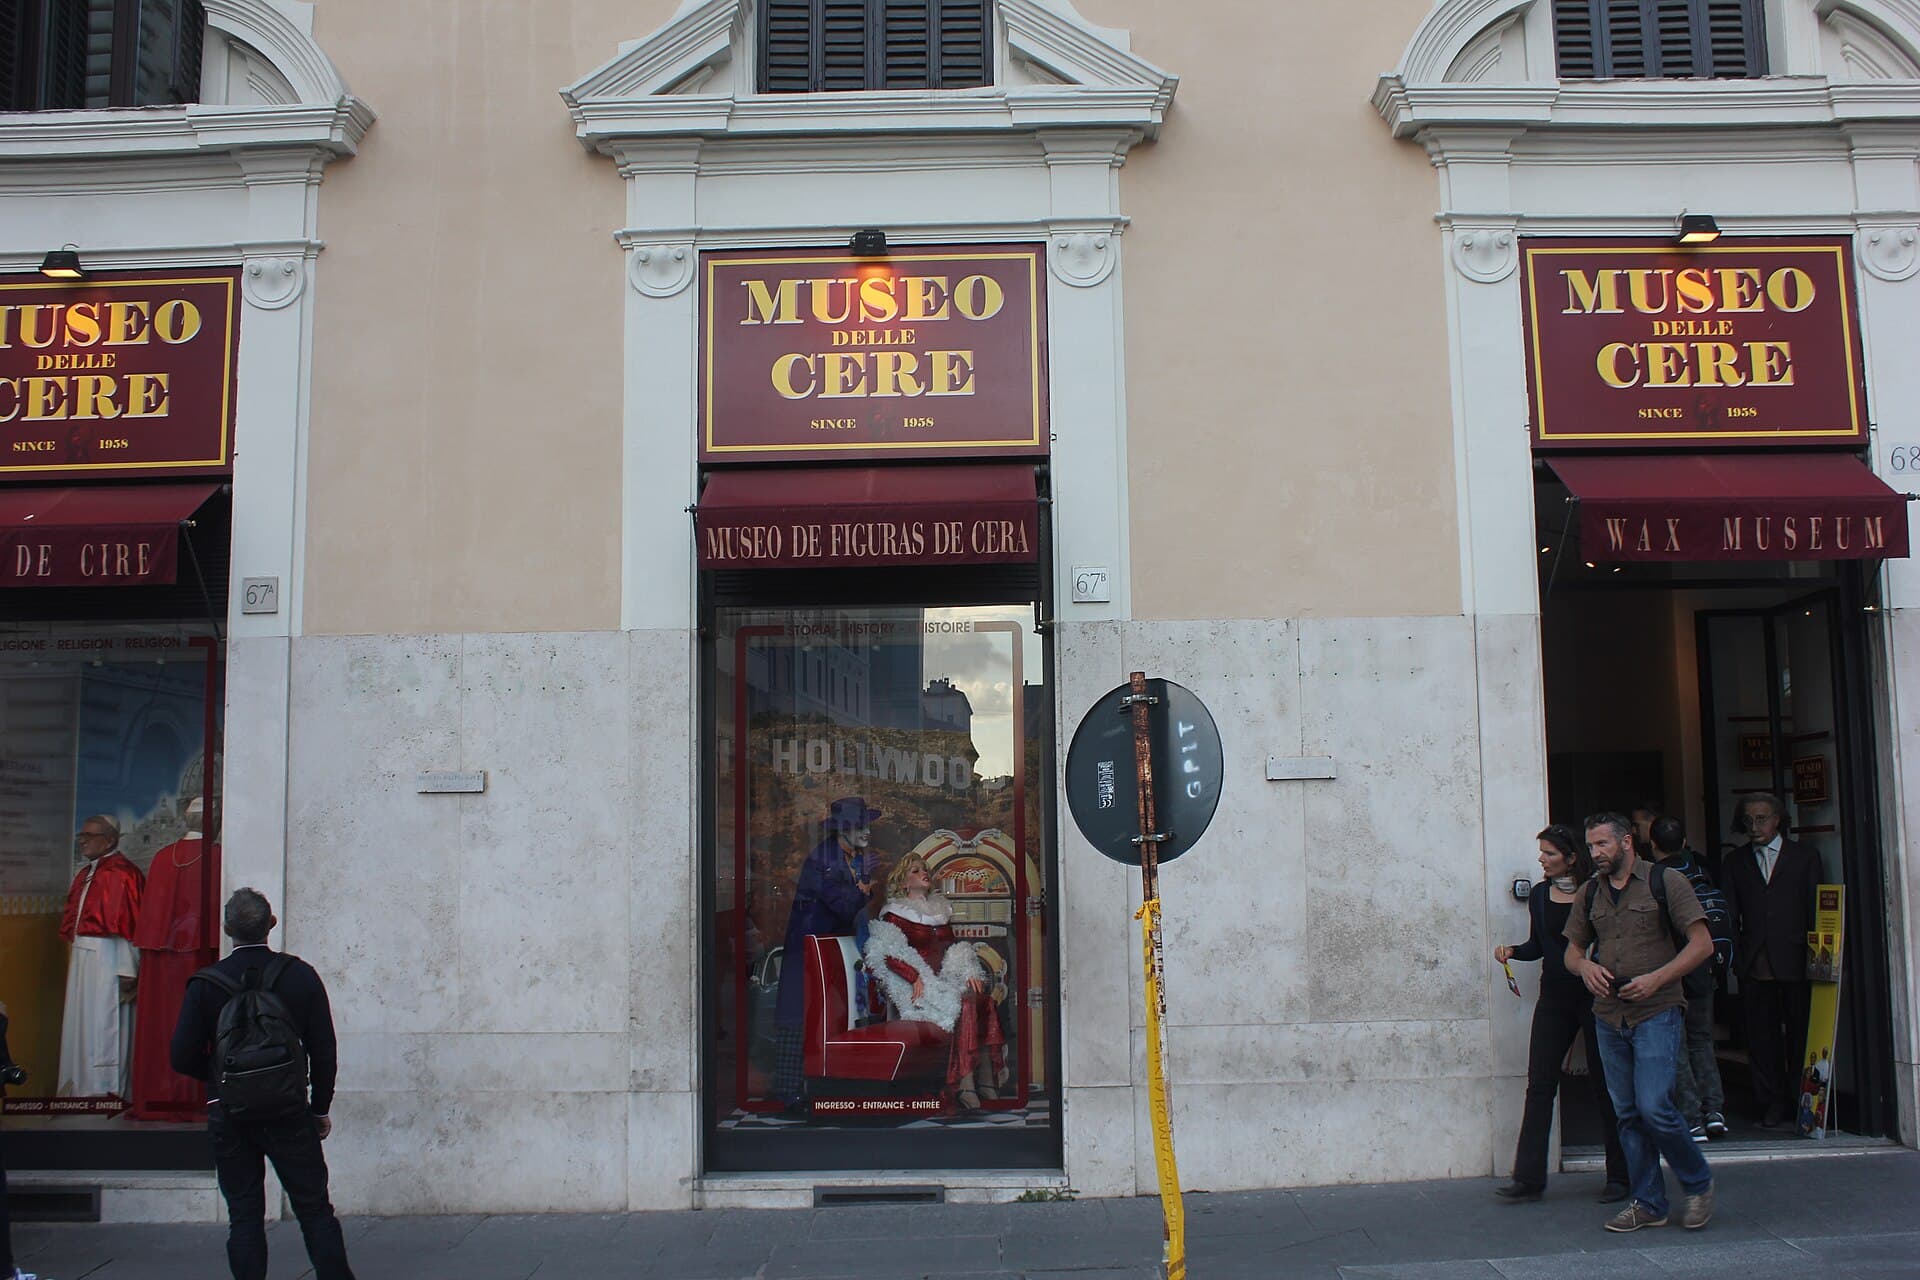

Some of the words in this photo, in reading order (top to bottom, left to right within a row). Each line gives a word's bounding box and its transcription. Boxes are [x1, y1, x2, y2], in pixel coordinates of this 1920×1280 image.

[739, 274, 1005, 326] MUSEO
[1559, 267, 1816, 314] MUSEO
[0, 299, 202, 348] USEO
[1652, 320, 1734, 336] DELLE
[831, 328, 916, 346] DELLE
[36, 353, 116, 370] DELLE
[1596, 341, 1795, 389] CERE
[771, 350, 976, 399] CERE
[810, 418, 857, 430] SINCE
[903, 416, 935, 428] 1958
[1638, 407, 1683, 418] SINCE
[1726, 407, 1757, 418] 1958
[13, 440, 56, 451] SINCE
[99, 439, 129, 449] 1958
[1891, 446, 1920, 471] 68
[706, 524, 783, 560] MUSEO
[791, 524, 823, 559] DE
[829, 521, 926, 558] FIGURAS
[933, 521, 966, 556] DE
[970, 519, 1031, 555] CERA
[1606, 517, 1681, 552] WAX
[1722, 515, 1885, 551] MUSEUM
[15, 544, 52, 577] DE
[80, 543, 151, 577] CIRE
[57, 638, 114, 650] RELIGION
[125, 637, 181, 649] RELIGION
[815, 1101, 855, 1110] INGRESSO
[862, 1101, 904, 1110] ENTRANCE
